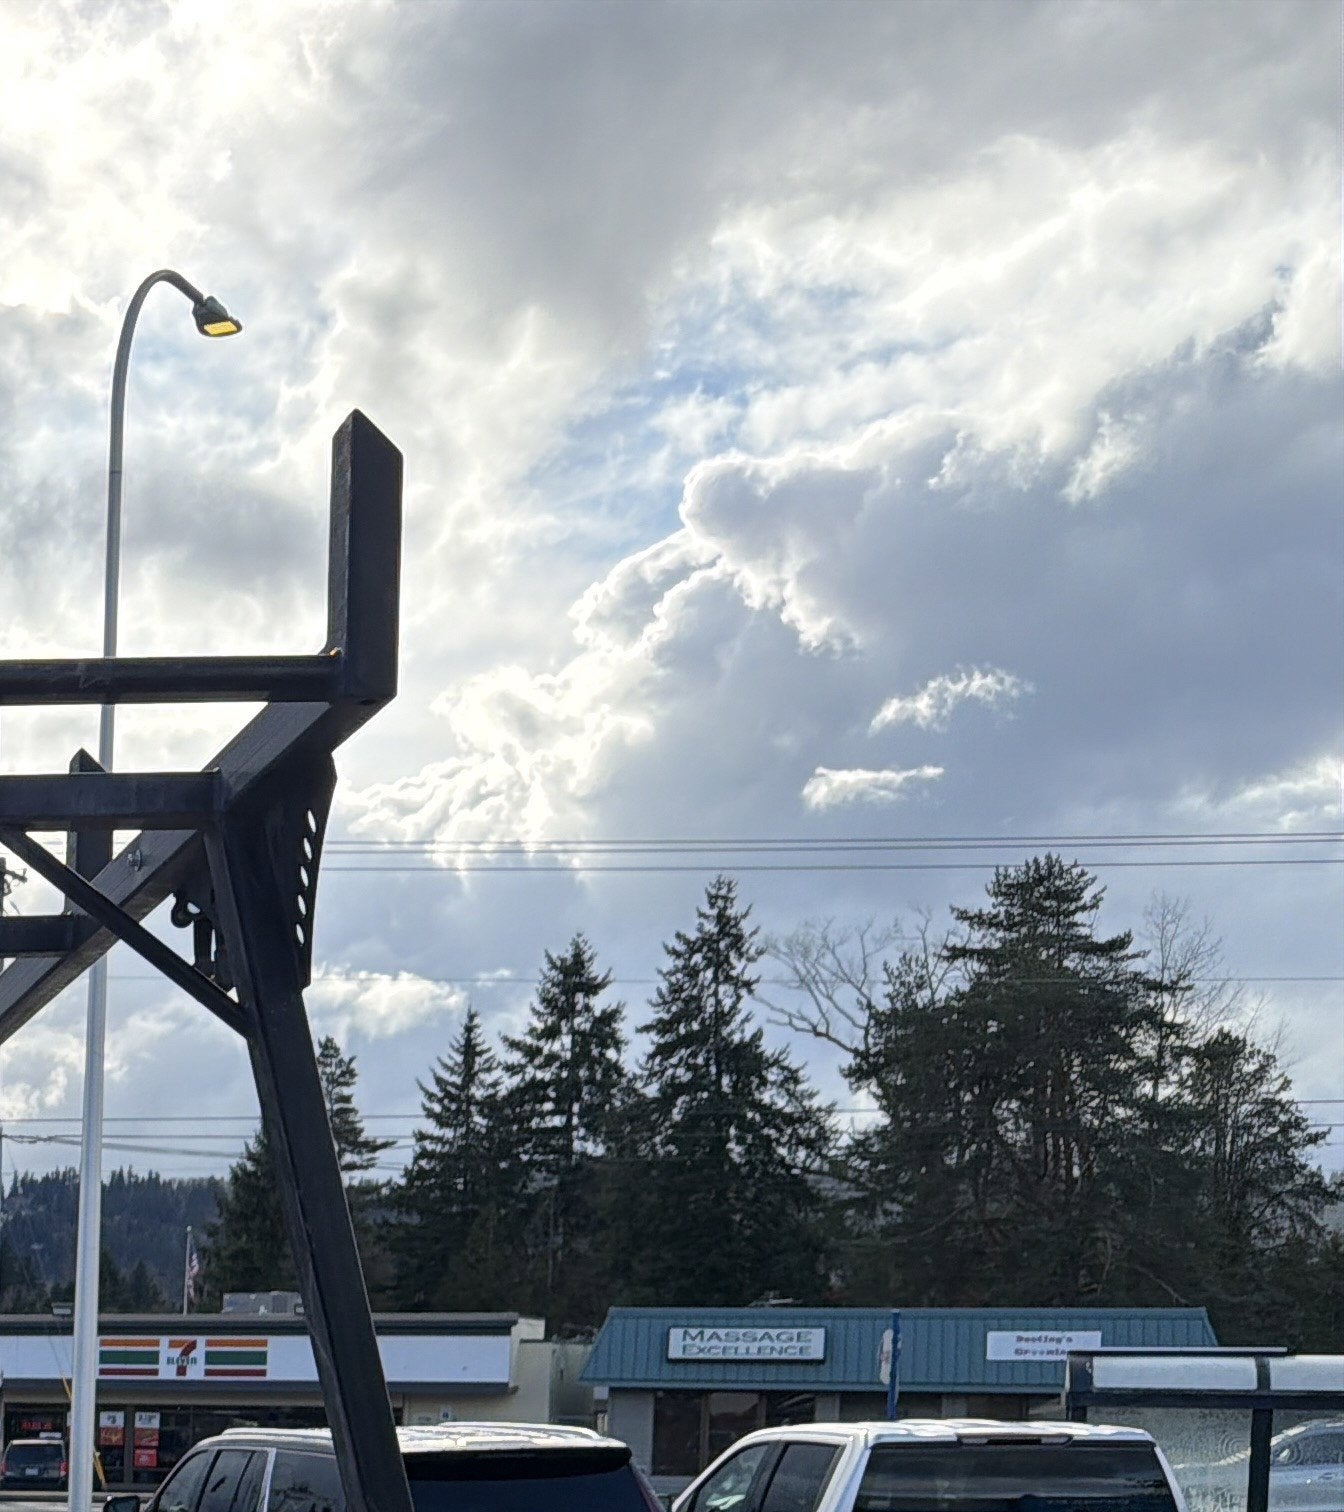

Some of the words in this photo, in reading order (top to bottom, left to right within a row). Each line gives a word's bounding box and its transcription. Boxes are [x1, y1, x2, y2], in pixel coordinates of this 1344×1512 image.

[682, 1329, 813, 1343] MASSAGE
[682, 1345, 812, 1356] EXCELLENCE
[1014, 1347, 1067, 1356] Groomin
[168, 1339, 197, 1377] 7
